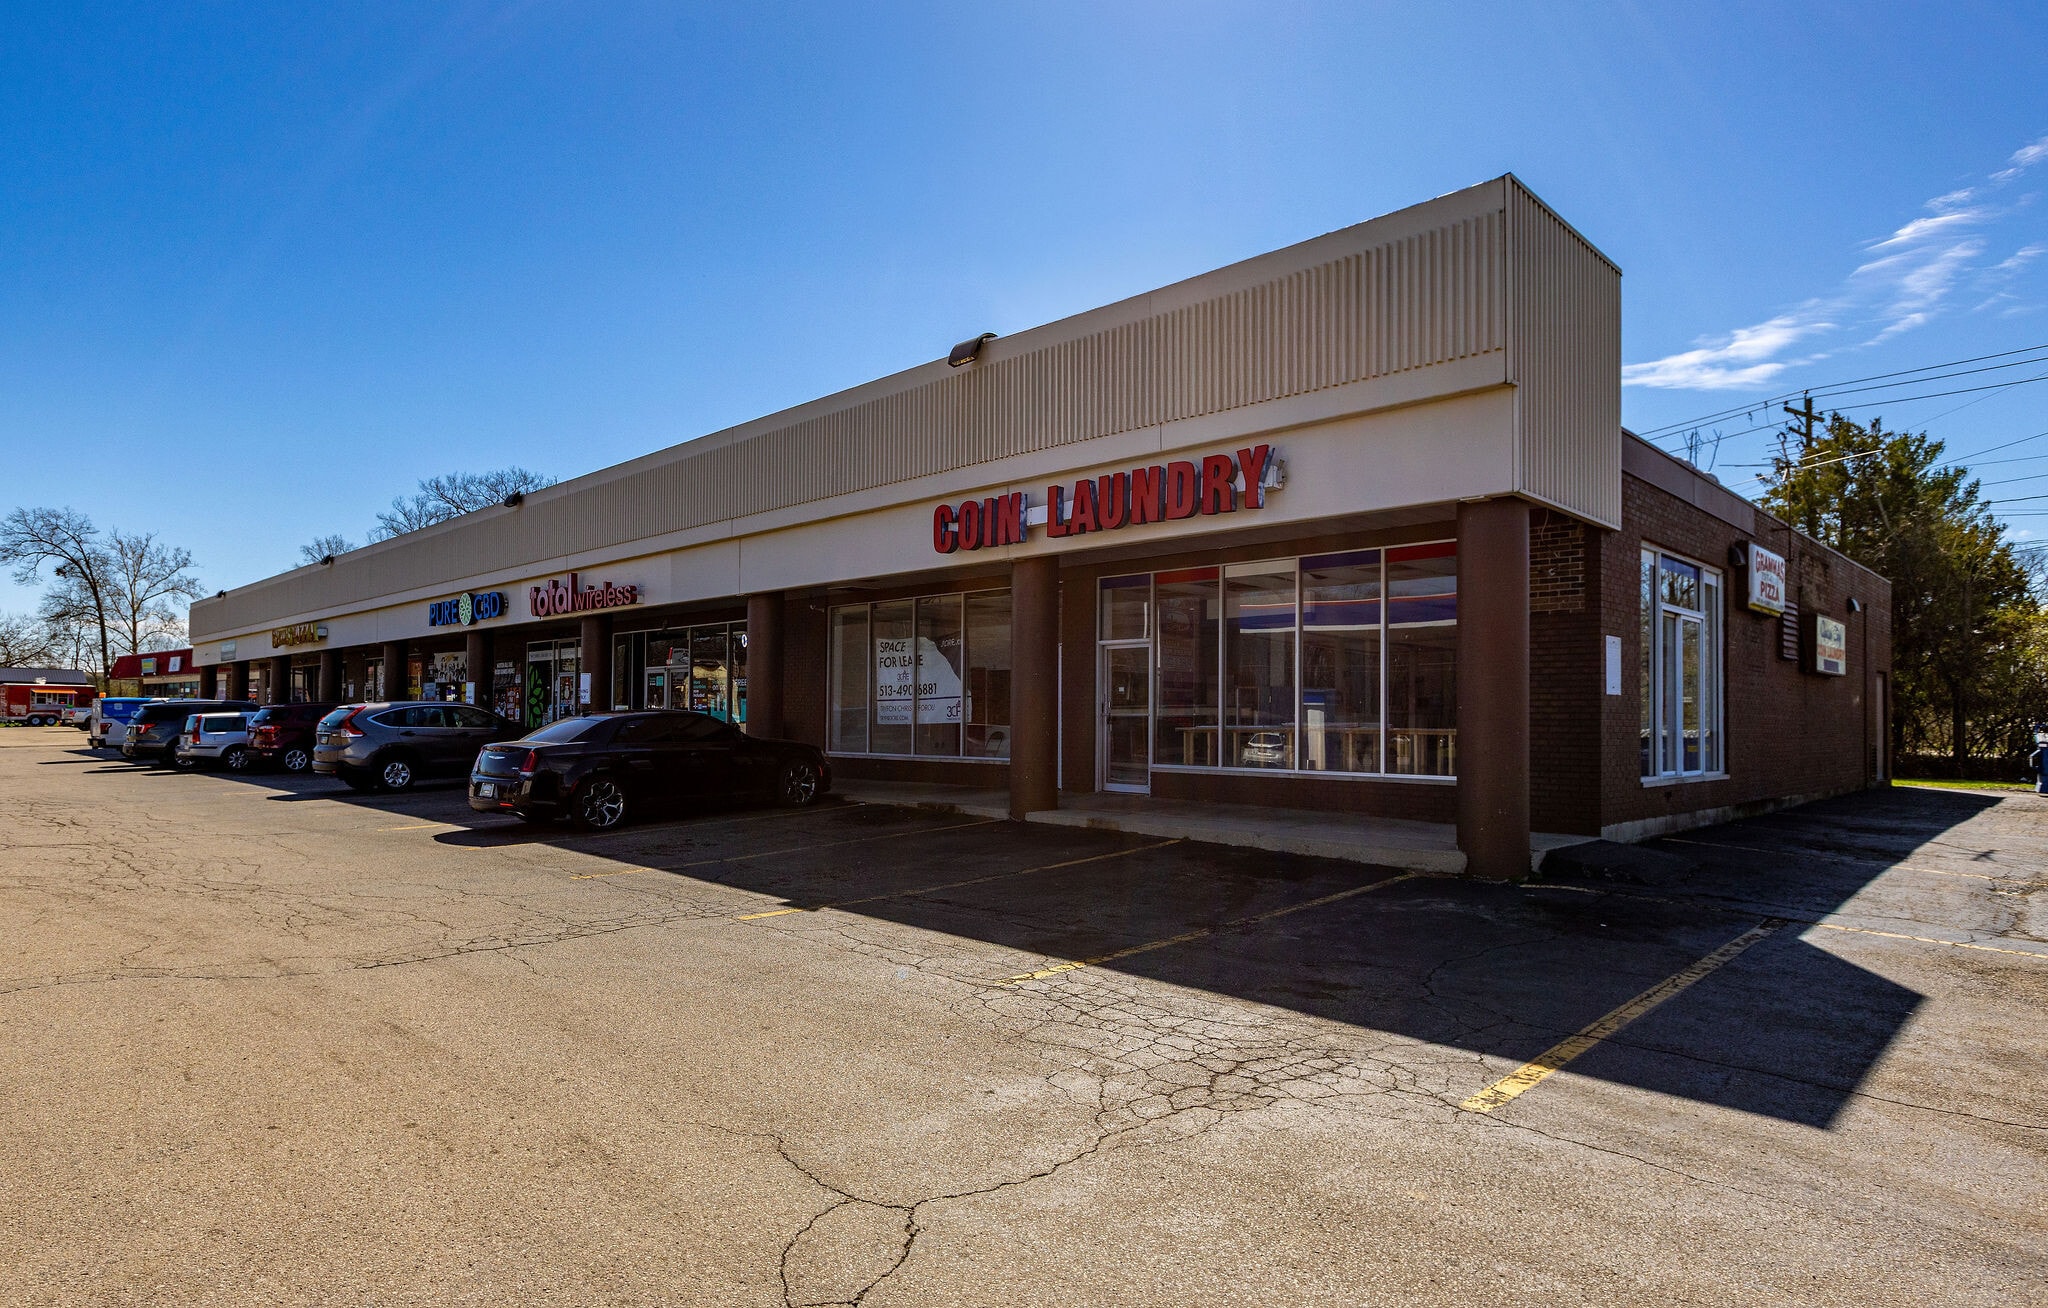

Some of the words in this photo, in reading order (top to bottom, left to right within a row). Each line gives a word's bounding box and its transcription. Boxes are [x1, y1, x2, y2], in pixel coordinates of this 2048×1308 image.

[933, 491, 1024, 554] COIN
[1047, 444, 1272, 538] LAUNDRY
[530, 573, 575, 617] total
[573, 582, 635, 610] wireless
[1760, 580, 1780, 602] PIZZA
[429, 599, 459, 626] PURE
[473, 591, 501, 619] CBD
[879, 641, 906, 653] SPACE
[879, 656, 897, 668] FOR
[899, 654, 924, 667] LEAE
[879, 683, 937, 696] 513-4906881
